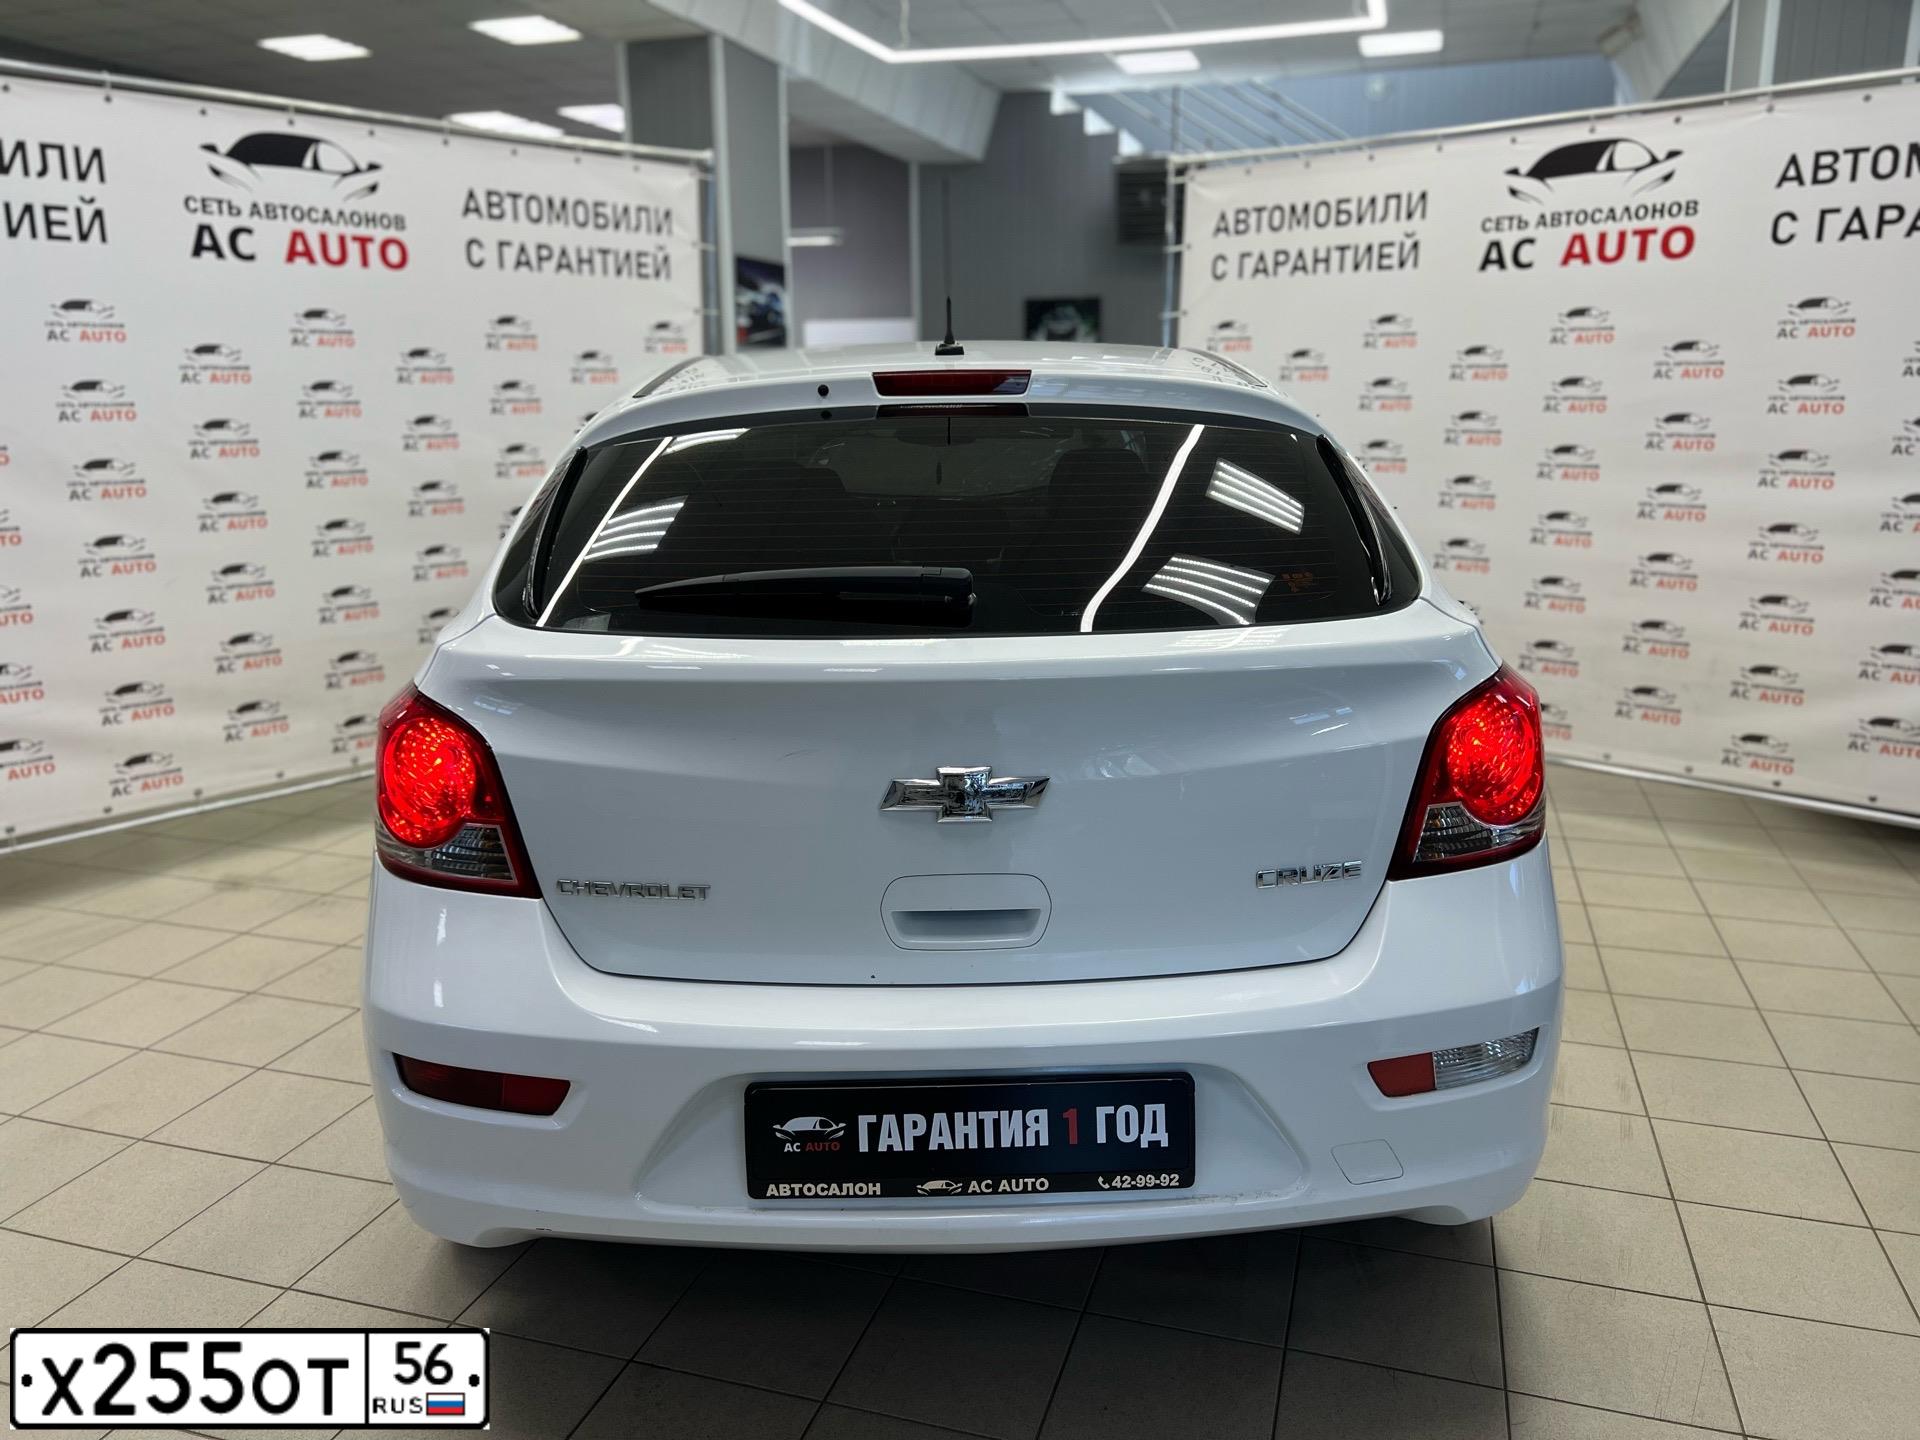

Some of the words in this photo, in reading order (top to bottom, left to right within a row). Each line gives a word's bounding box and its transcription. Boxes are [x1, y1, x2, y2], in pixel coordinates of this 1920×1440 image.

[184, 195, 242, 217] СЕТЬ
[249, 200, 408, 231] АВТОСАЛОНОВ
[462, 187, 674, 237] АВТОМОБИЛИ
[1213, 190, 1429, 238] АВТОМОБИЛИ
[1481, 213, 1530, 233] СЕТЬ
[1535, 199, 1700, 229] АВТОСАЛОНОВ
[1771, 209, 1799, 246] С
[285, 227, 410, 271] AUTO
[1559, 224, 1696, 267] AUTO
[465, 238, 486, 269] С
[497, 240, 672, 281] ГАРАНТИЕЙ
[1210, 253, 1229, 281] С
[1237, 232, 1421, 280] ГАРАНТИЕЙ
[80, 330, 127, 344] AUTO
[1573, 332, 1615, 346] AUTO
[1808, 326, 1855, 338] AUTO
[208, 373, 251, 385] AUTO
[1681, 369, 1723, 380] AUTO
[90, 410, 137, 423] AUTO
[1798, 403, 1844, 415] AUTO
[1673, 439, 1715, 451] AUTO
[219, 448, 259, 459] AUTO
[1560, 469, 1600, 482] AUTO
[100, 485, 148, 500] AUTO
[1787, 478, 1835, 491] AUTO
[227, 518, 268, 530] AUTO
[1664, 510, 1706, 522] AUTO
[1776, 552, 1823, 563] AUTO
[112, 561, 156, 577] AUTO
[235, 588, 276, 602] AUTO
[1769, 622, 1813, 637] AUTO
[122, 634, 165, 650] AUTO
[1648, 647, 1688, 660] AUTO
[0, 689, 43, 705] AUTO
[1760, 690, 1803, 706] AUTO
[131, 705, 176, 721] AUTO
[7, 764, 55, 781] AUTO
[1748, 759, 1795, 776] AUTO
[141, 774, 185, 792] AUTO
[1256, 860, 1362, 889] CRUZE
[556, 879, 711, 900] CHEVROLET
[857, 1108, 1049, 1153] ГАРАНТИЯ
[1062, 1107, 1079, 1145] 1
[1095, 1103, 1169, 1149] ГОД
[805, 1141, 841, 1152] AUTO
[766, 1182, 881, 1197] АВТОСАЛОН
[998, 1178, 1050, 1192] AUTO
[1111, 1173, 1180, 1189] 42-99-92
